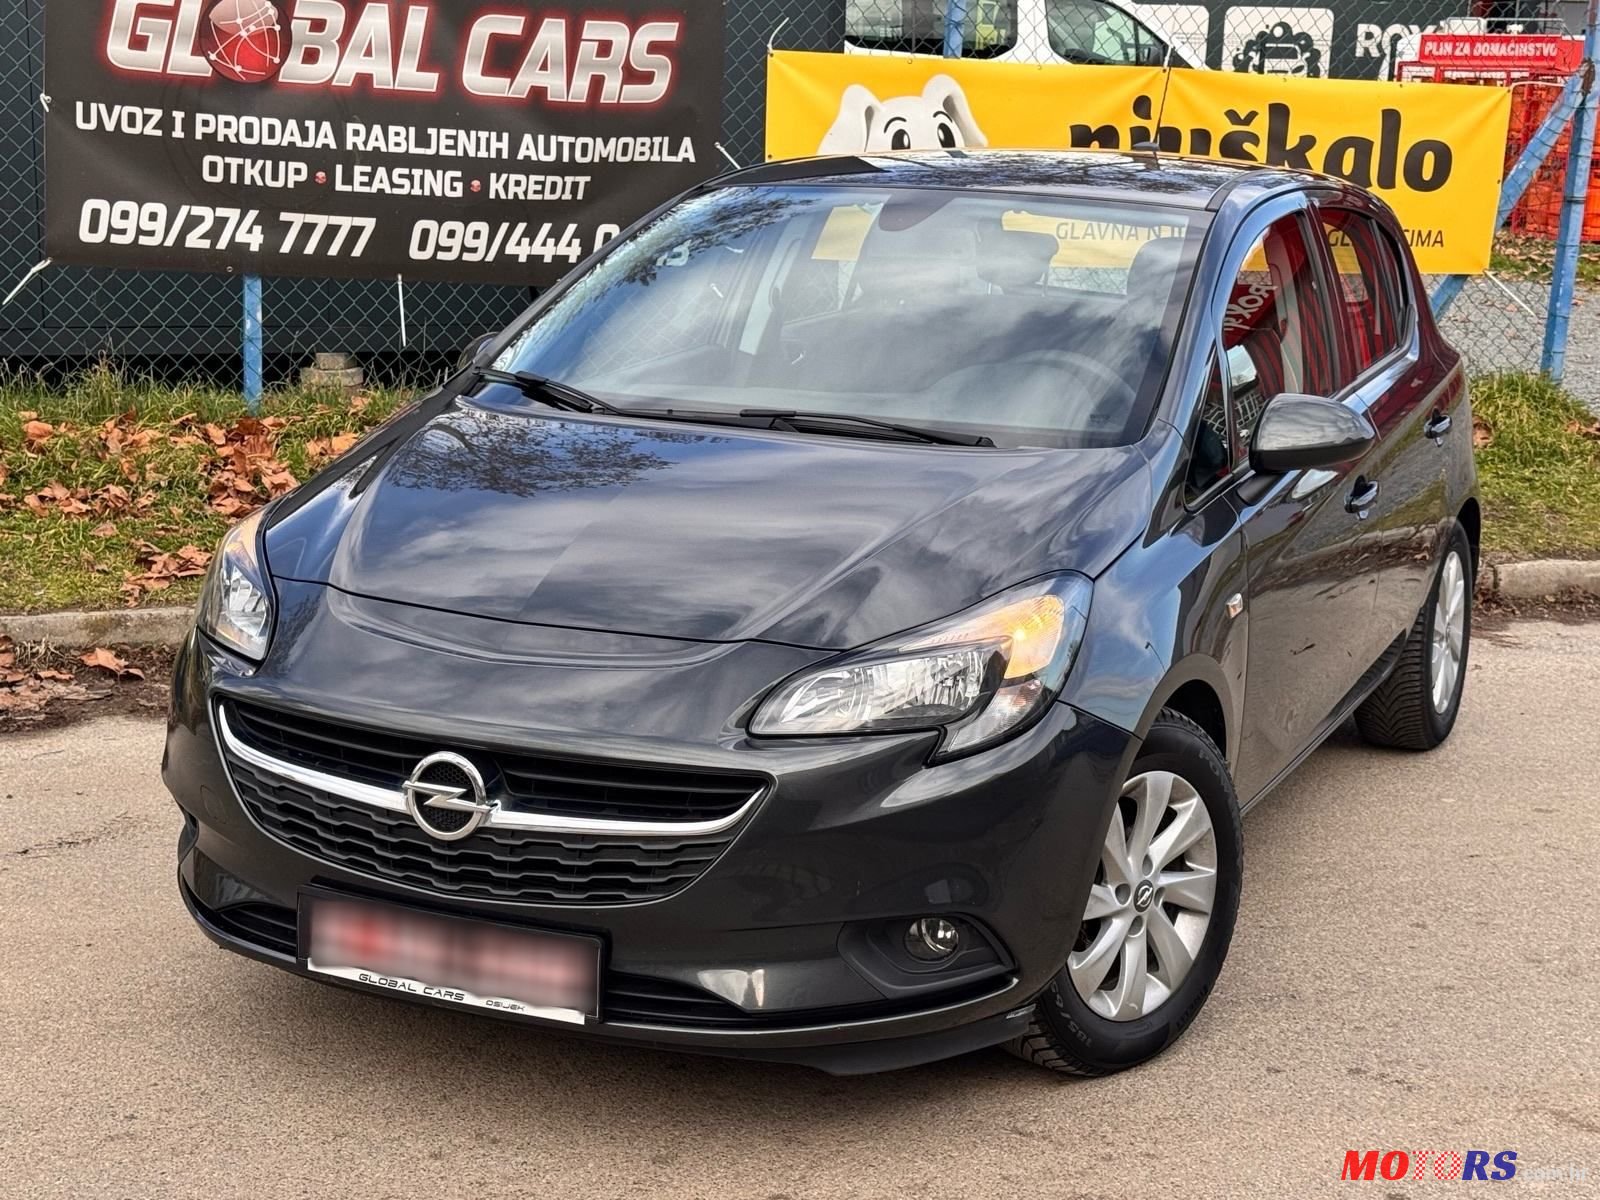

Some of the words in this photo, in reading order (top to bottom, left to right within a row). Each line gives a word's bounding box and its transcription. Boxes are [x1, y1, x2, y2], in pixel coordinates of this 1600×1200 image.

[462, 14, 679, 104] CARS
[1424, 41, 1452, 56] PLIN
[1455, 42, 1470, 56] ZA
[76, 101, 163, 136] UVOZ
[172, 111, 184, 138] I
[195, 113, 338, 149] PRODAJA
[346, 123, 509, 160] RABLJENIH
[517, 134, 696, 163] AUTOMOBILA
[203, 155, 307, 189] OTKUP
[335, 164, 463, 198] LEASING
[489, 173, 591, 200] KREDIT
[79, 199, 264, 252] 099/274
[280, 212, 376, 257] 7777
[409, 220, 582, 264] 099/444
[1055, 222, 1139, 242] GLAVNA
[358, 973, 417, 992] GLOBAL
[423, 987, 465, 1002] CARS
